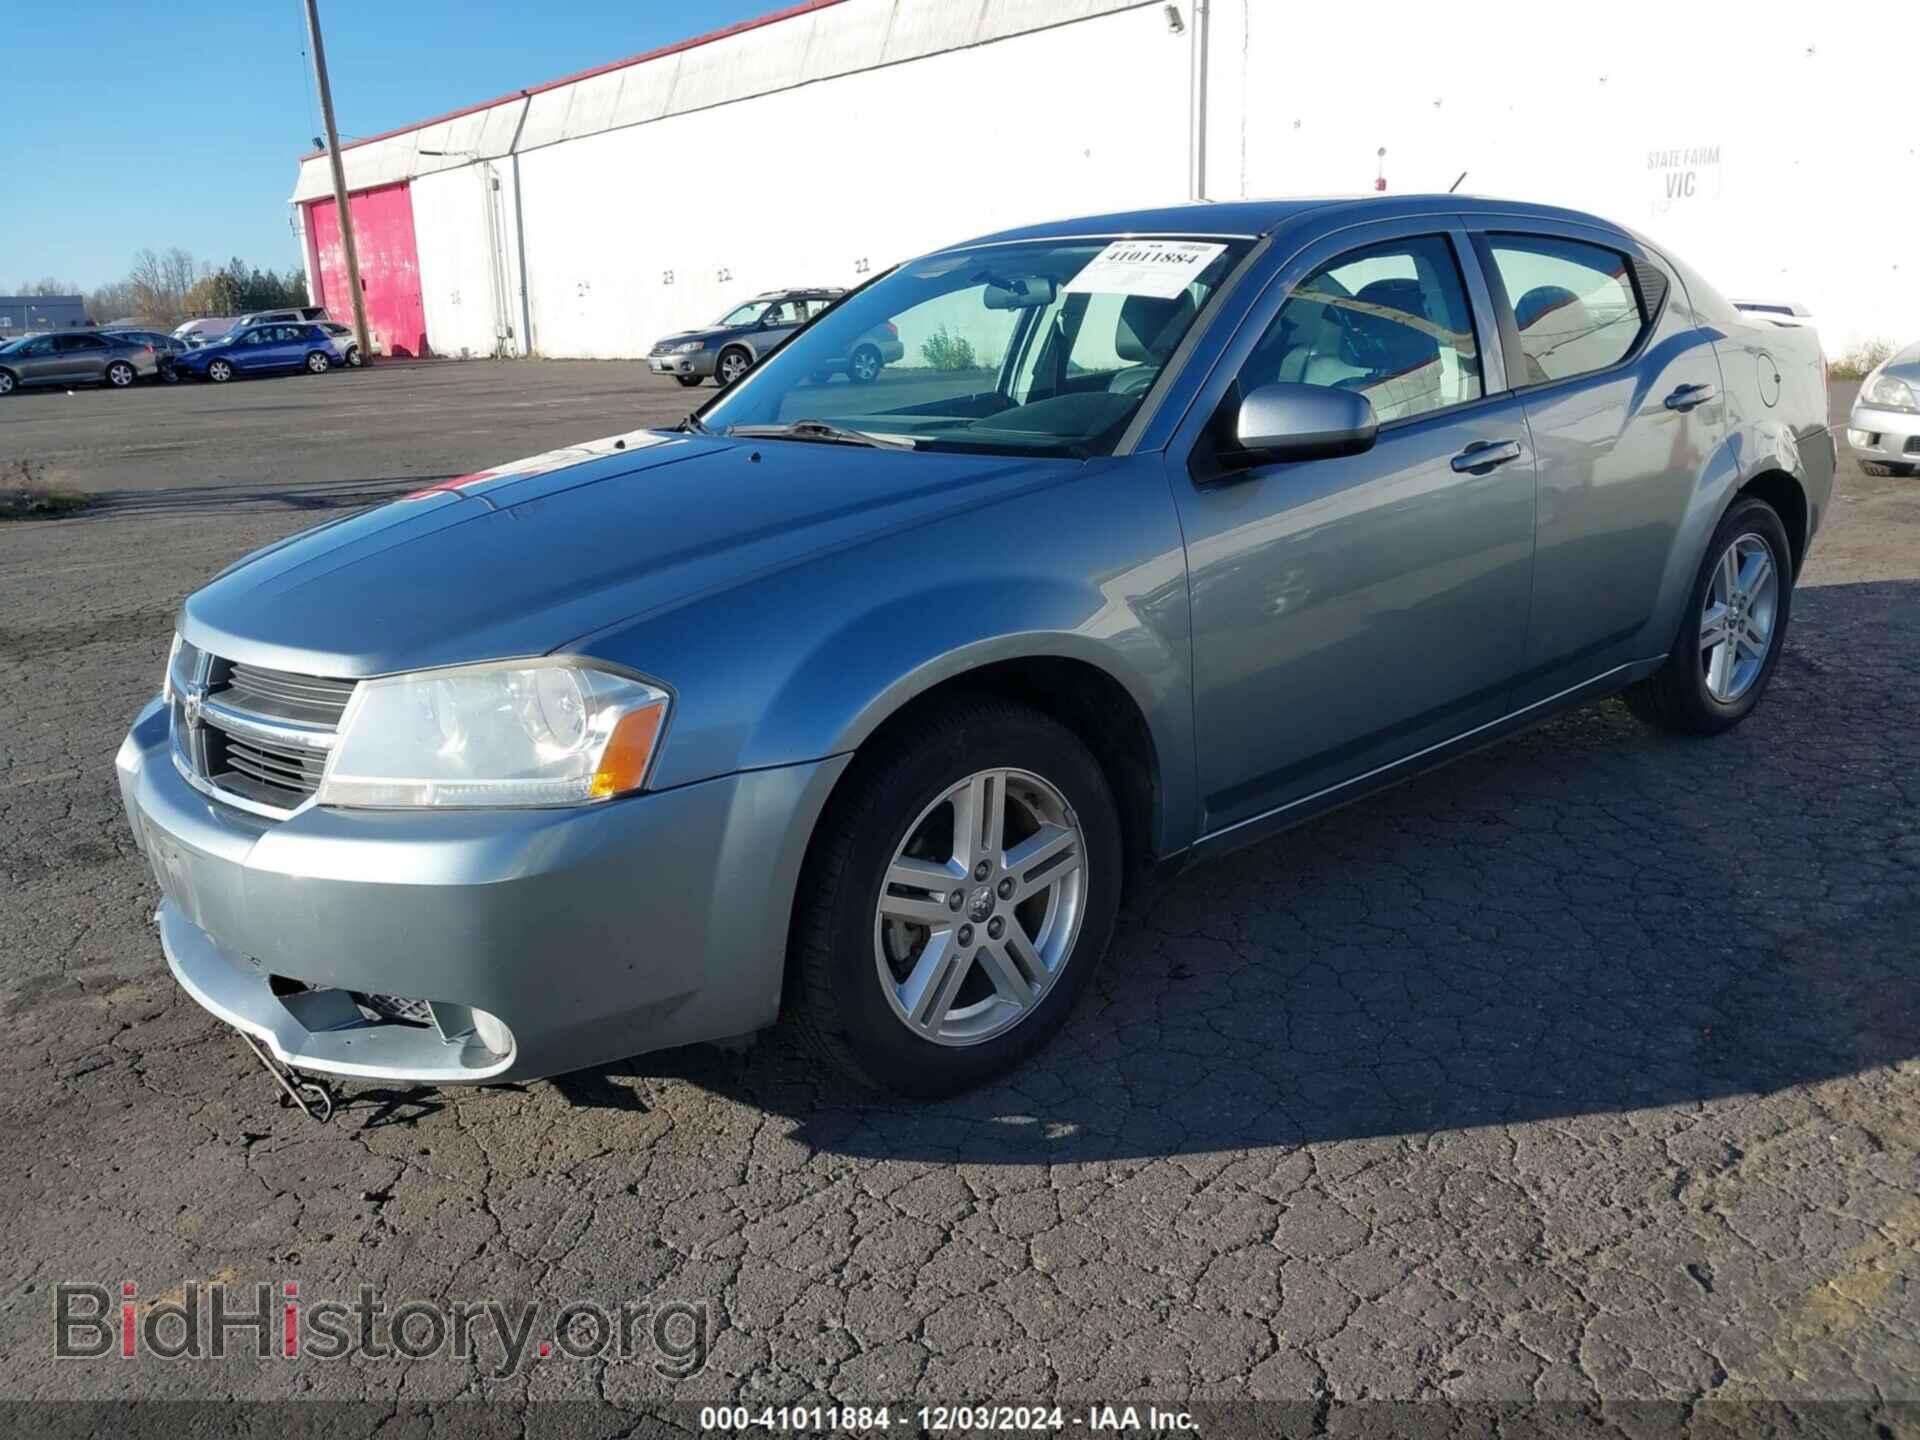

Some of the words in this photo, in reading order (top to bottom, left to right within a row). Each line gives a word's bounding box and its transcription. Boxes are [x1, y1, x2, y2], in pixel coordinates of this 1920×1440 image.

[1647, 150, 1681, 170] STATE
[1665, 171, 1696, 199] VIC
[1107, 250, 1200, 265] 41011884
